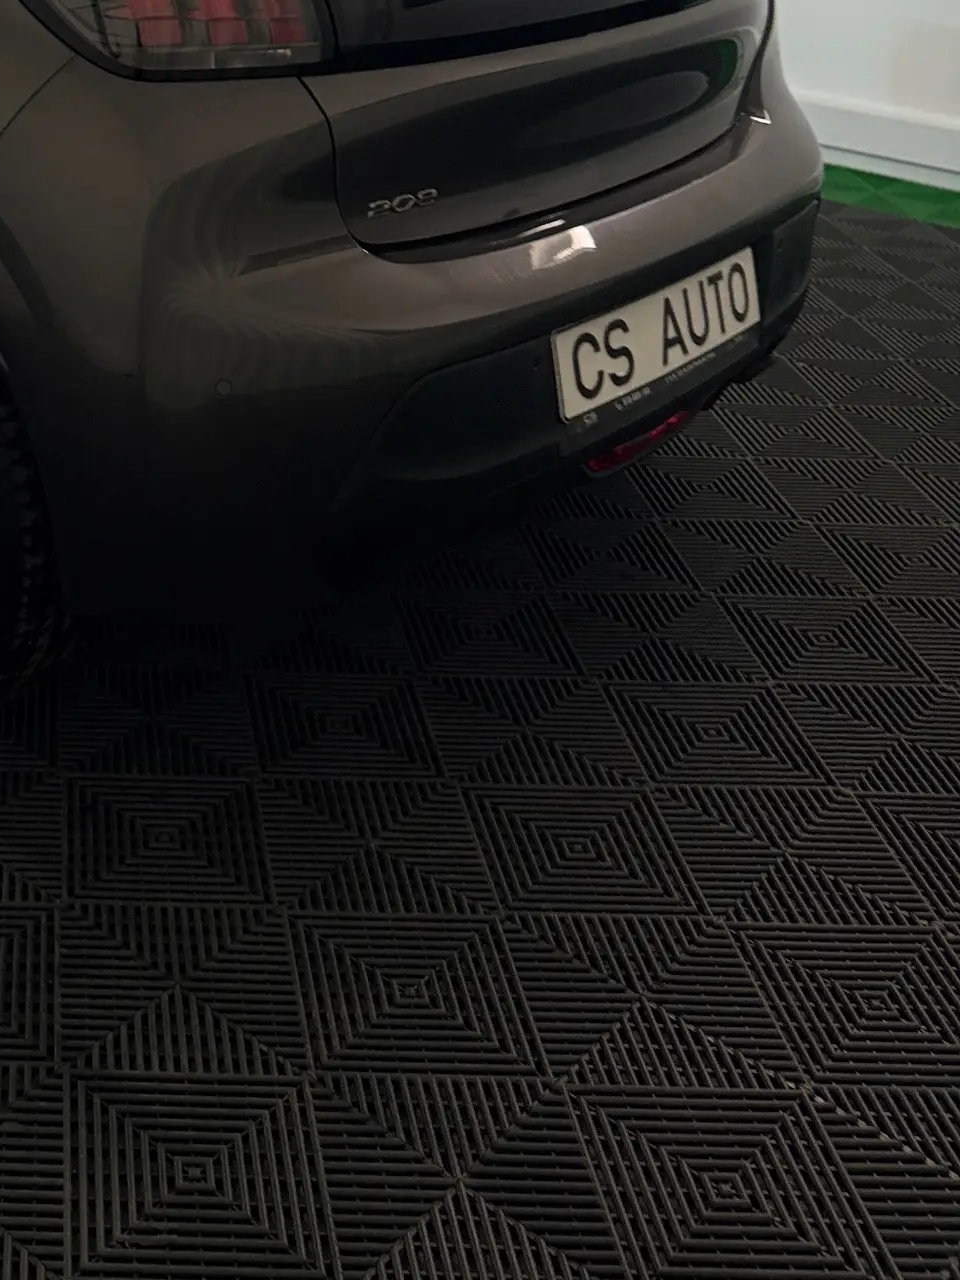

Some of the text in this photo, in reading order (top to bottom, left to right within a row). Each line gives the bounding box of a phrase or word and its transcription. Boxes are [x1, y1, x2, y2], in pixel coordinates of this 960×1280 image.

[367, 189, 438, 218] 208
[572, 318, 635, 399] CS
[662, 262, 749, 366] AUTO
